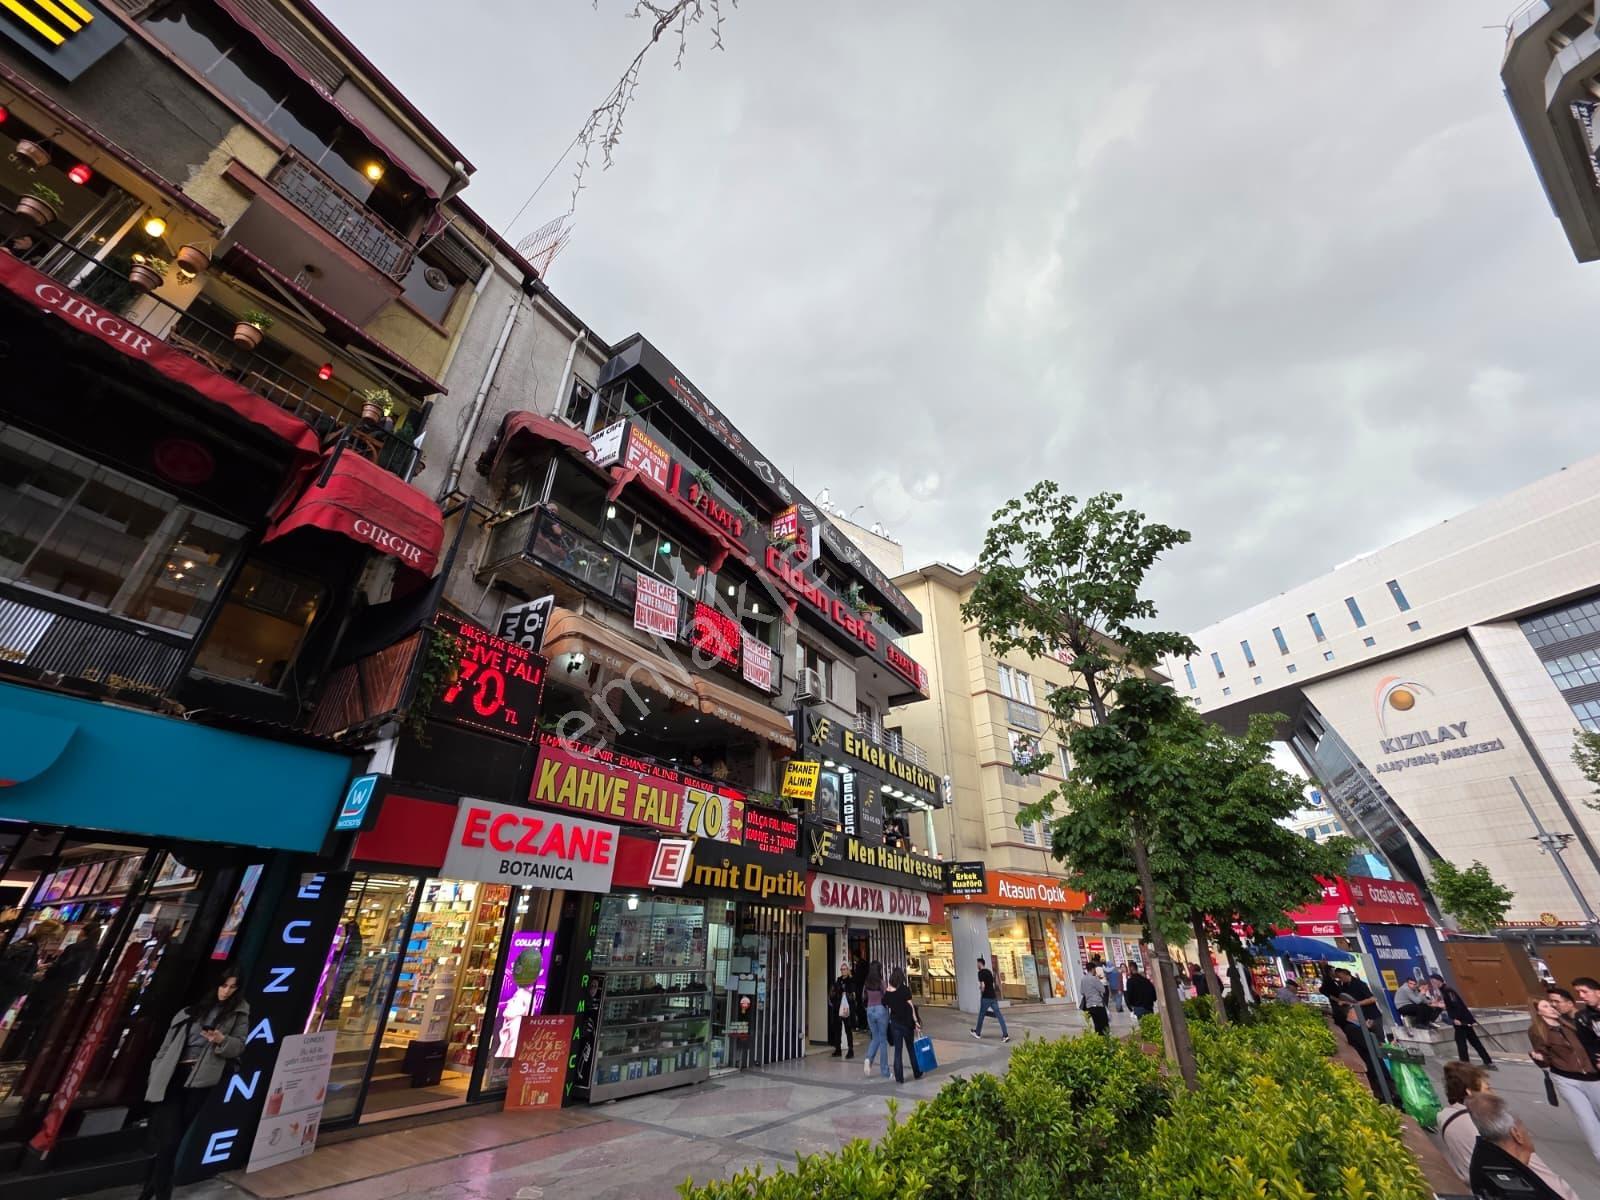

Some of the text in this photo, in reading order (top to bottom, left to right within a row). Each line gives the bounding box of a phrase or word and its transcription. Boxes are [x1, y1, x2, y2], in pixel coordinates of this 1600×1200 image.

[627, 446, 666, 487] FAL
[773, 521, 796, 538] FAL
[766, 546, 878, 651] Cidan Cafe
[505, 657, 541, 685] FALI
[443, 658, 506, 717] 70
[504, 708, 518, 725] TL
[1379, 720, 1469, 755] KIZILAY
[1440, 737, 1505, 761] MERKEZİ
[619, 755, 652, 774] EMANET
[787, 763, 818, 775] EMANET
[844, 730, 888, 771] Erkek
[888, 752, 936, 794] Kuaförü
[787, 775, 813, 788] ALINIR
[535, 758, 630, 818] KAHVE
[632, 782, 679, 829] FALI
[686, 788, 723, 839] 70
[842, 773, 856, 836] BERBER
[460, 807, 613, 865] ECZANE
[499, 859, 574, 881] BOTANICA
[659, 849, 681, 876] E
[848, 838, 876, 866] Men
[878, 846, 943, 881] Hairdresser
[744, 863, 806, 899] Optik
[952, 879, 983, 888] Kuaförü
[955, 872, 978, 881] Erkek
[820, 879, 885, 913] SAKARYA
[998, 879, 1067, 905] Atasun Optik
[514, 938, 551, 947] COLLAGN
[564, 901, 601, 1098] PHARMACY
[519, 1062, 529, 1074] 3
[536, 1062, 546, 1073] 2
